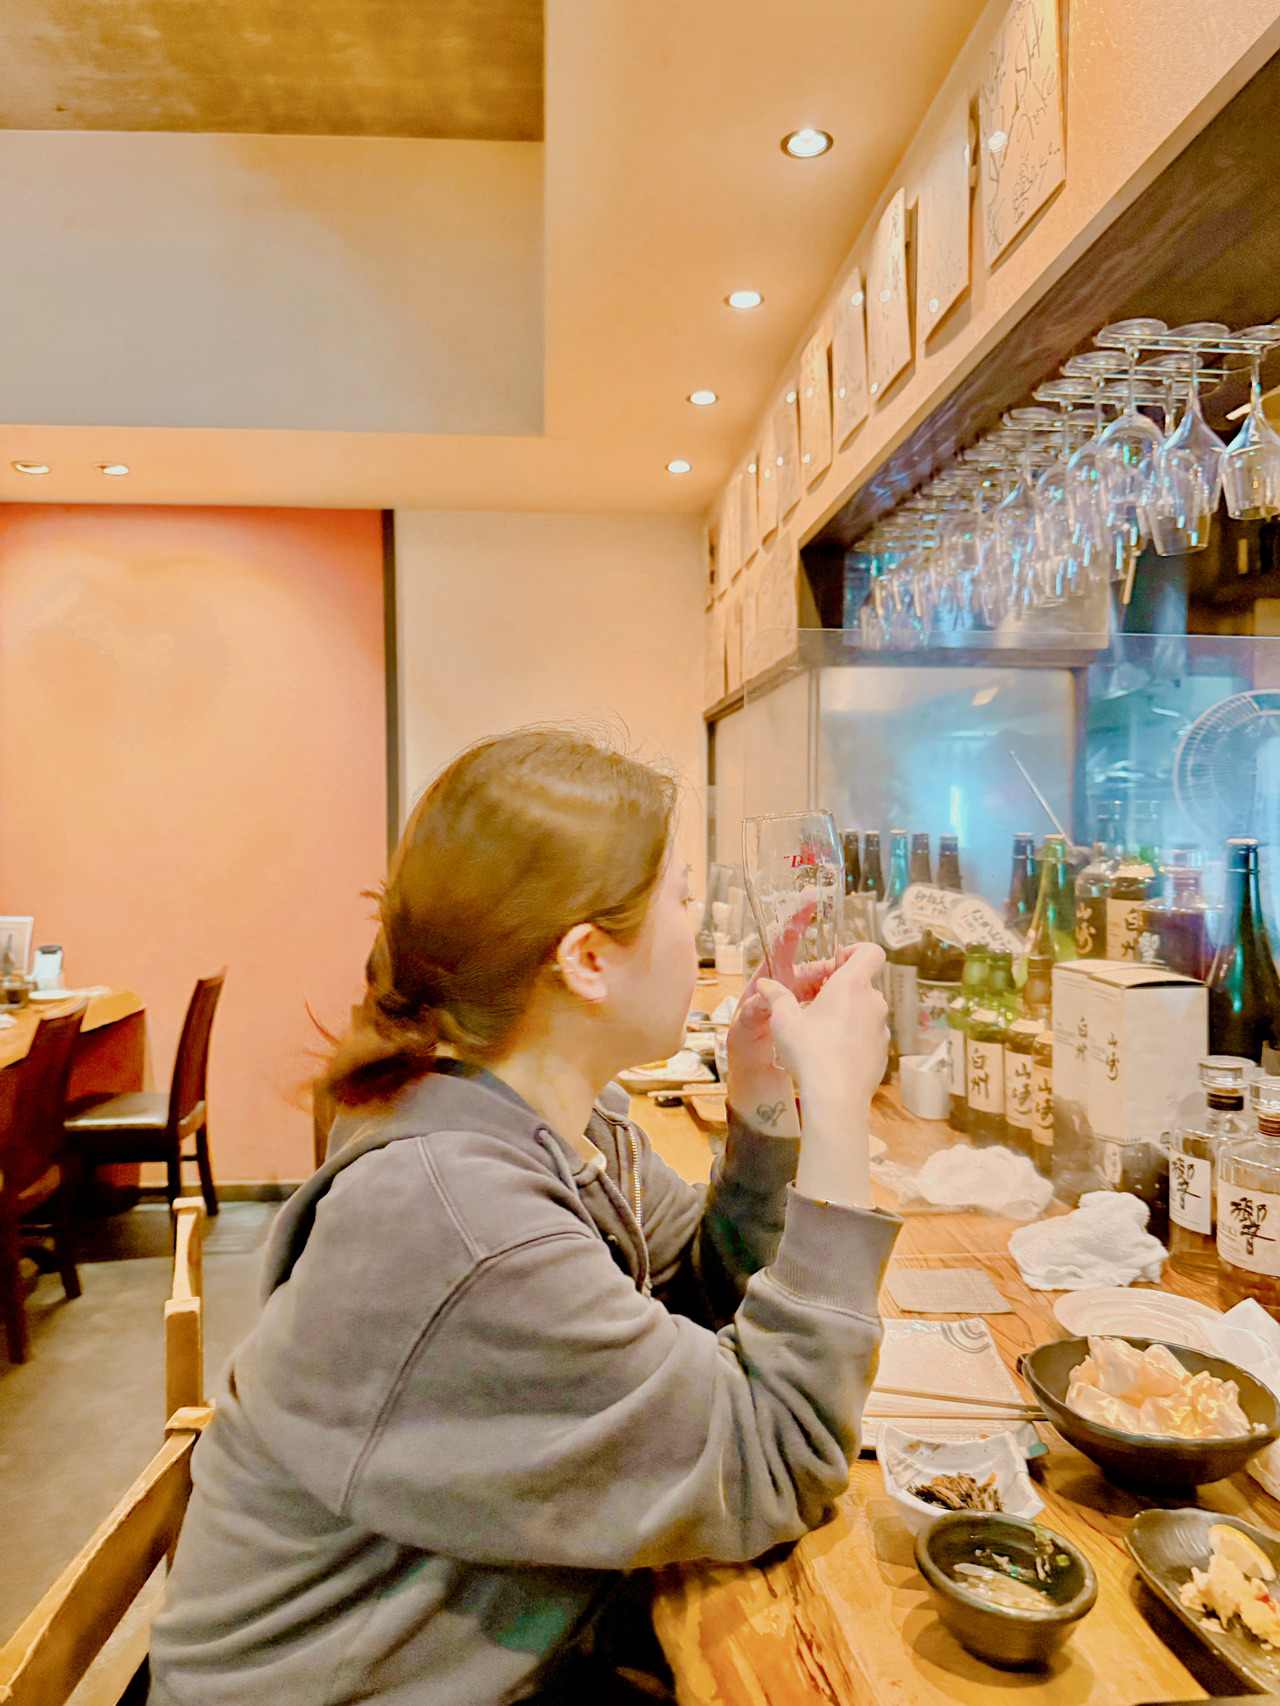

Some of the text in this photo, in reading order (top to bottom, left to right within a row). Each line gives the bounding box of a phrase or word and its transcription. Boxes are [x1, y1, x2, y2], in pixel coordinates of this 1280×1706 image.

[970, 1047, 990, 1099] 白州
[1171, 1156, 1202, 1211] 響
[1229, 1196, 1277, 1256] 響
